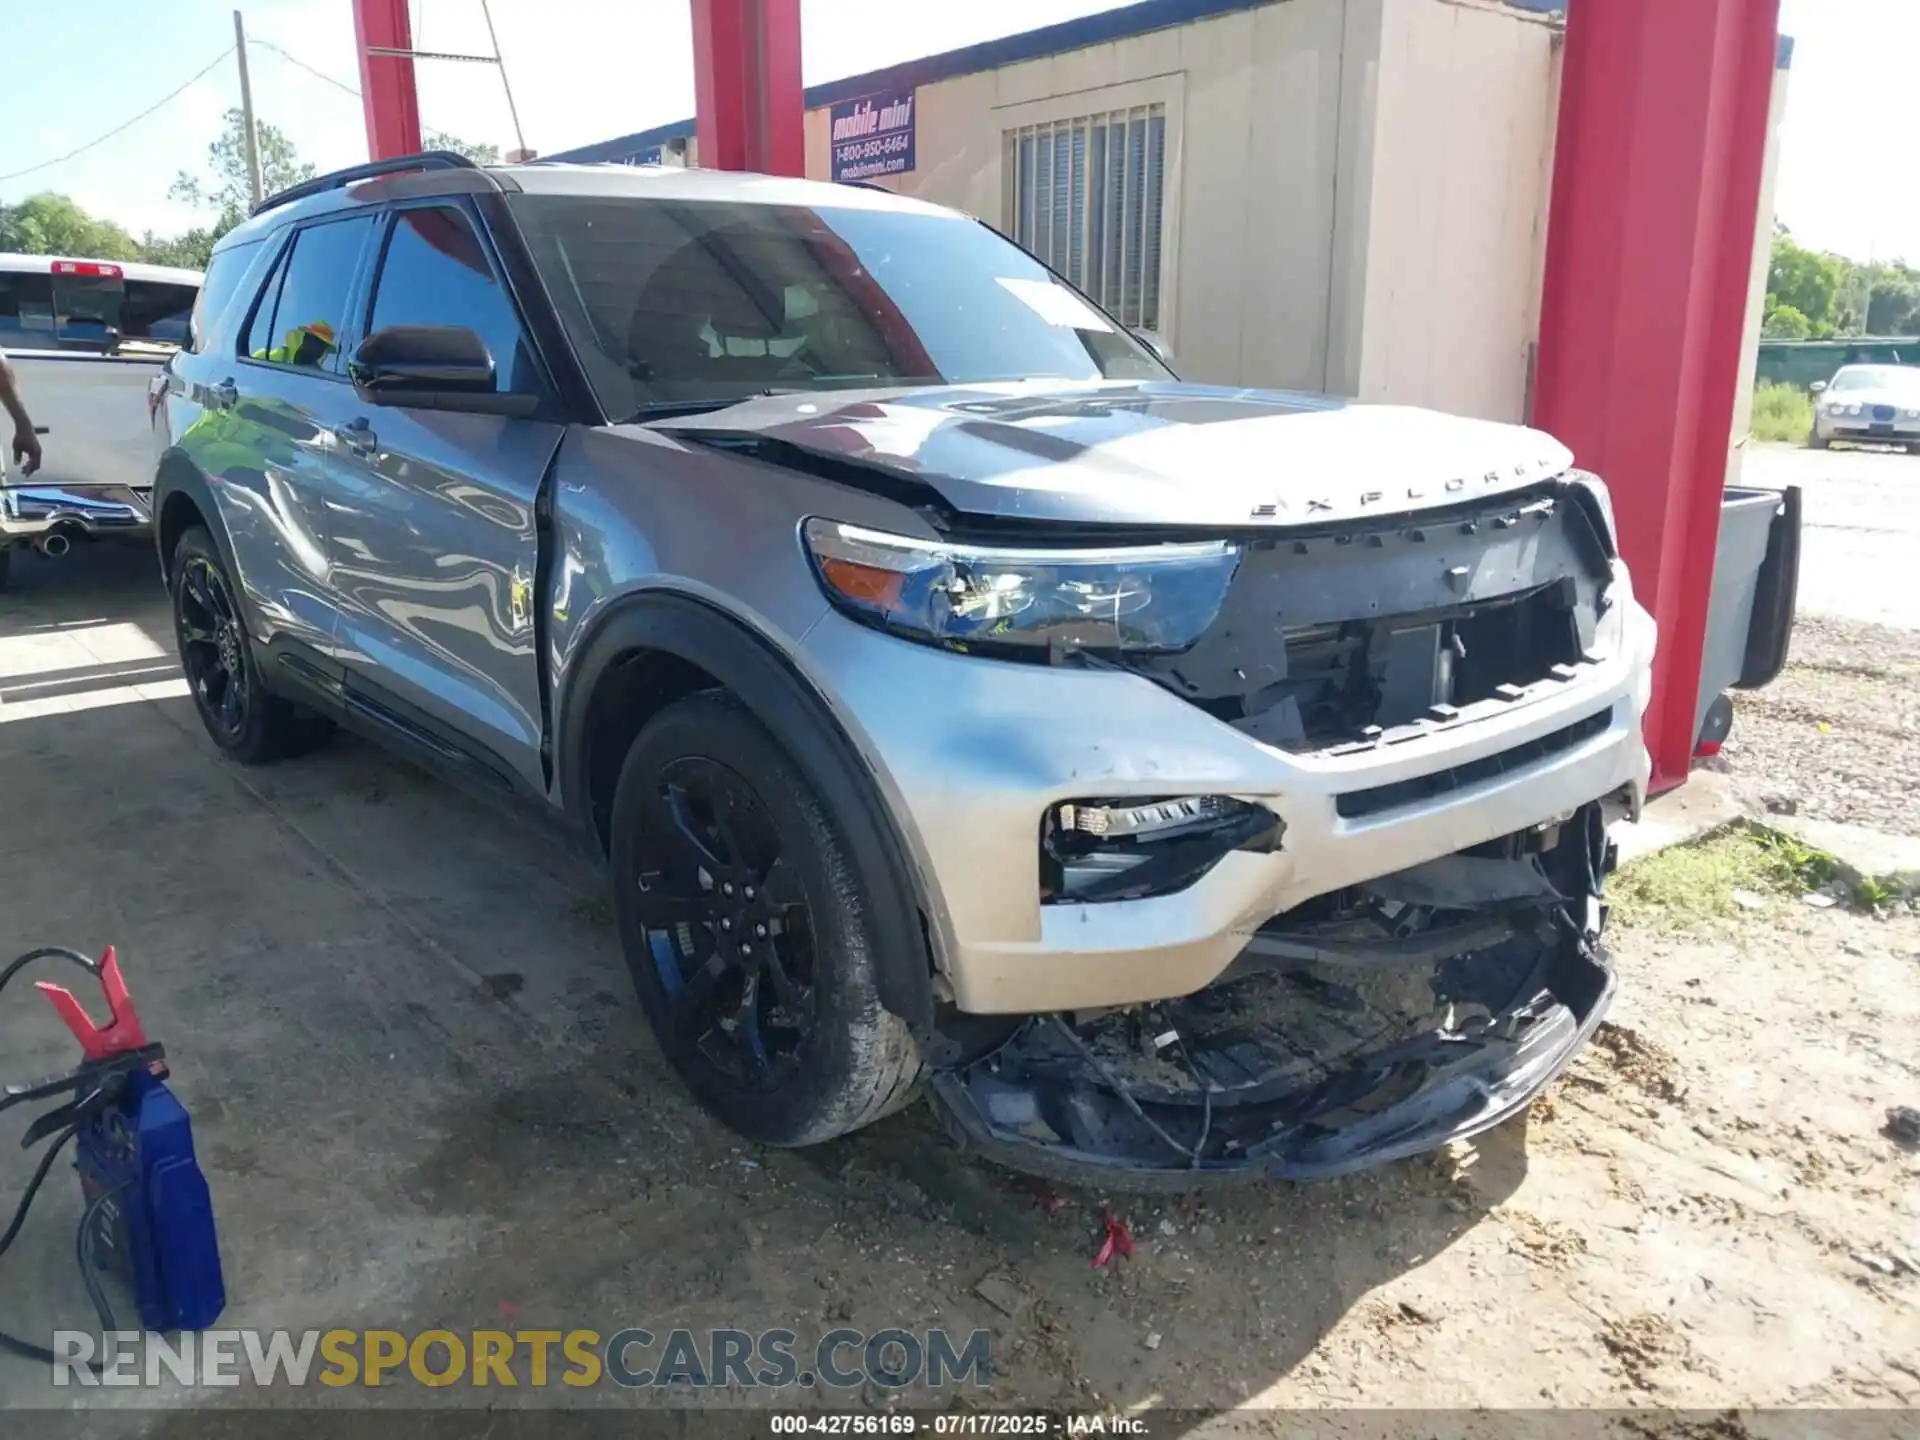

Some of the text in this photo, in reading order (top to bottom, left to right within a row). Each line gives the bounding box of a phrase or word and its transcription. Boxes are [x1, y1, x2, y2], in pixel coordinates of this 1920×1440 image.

[833, 96, 912, 140] mobile mini
[841, 157, 905, 180] mobilemini.com
